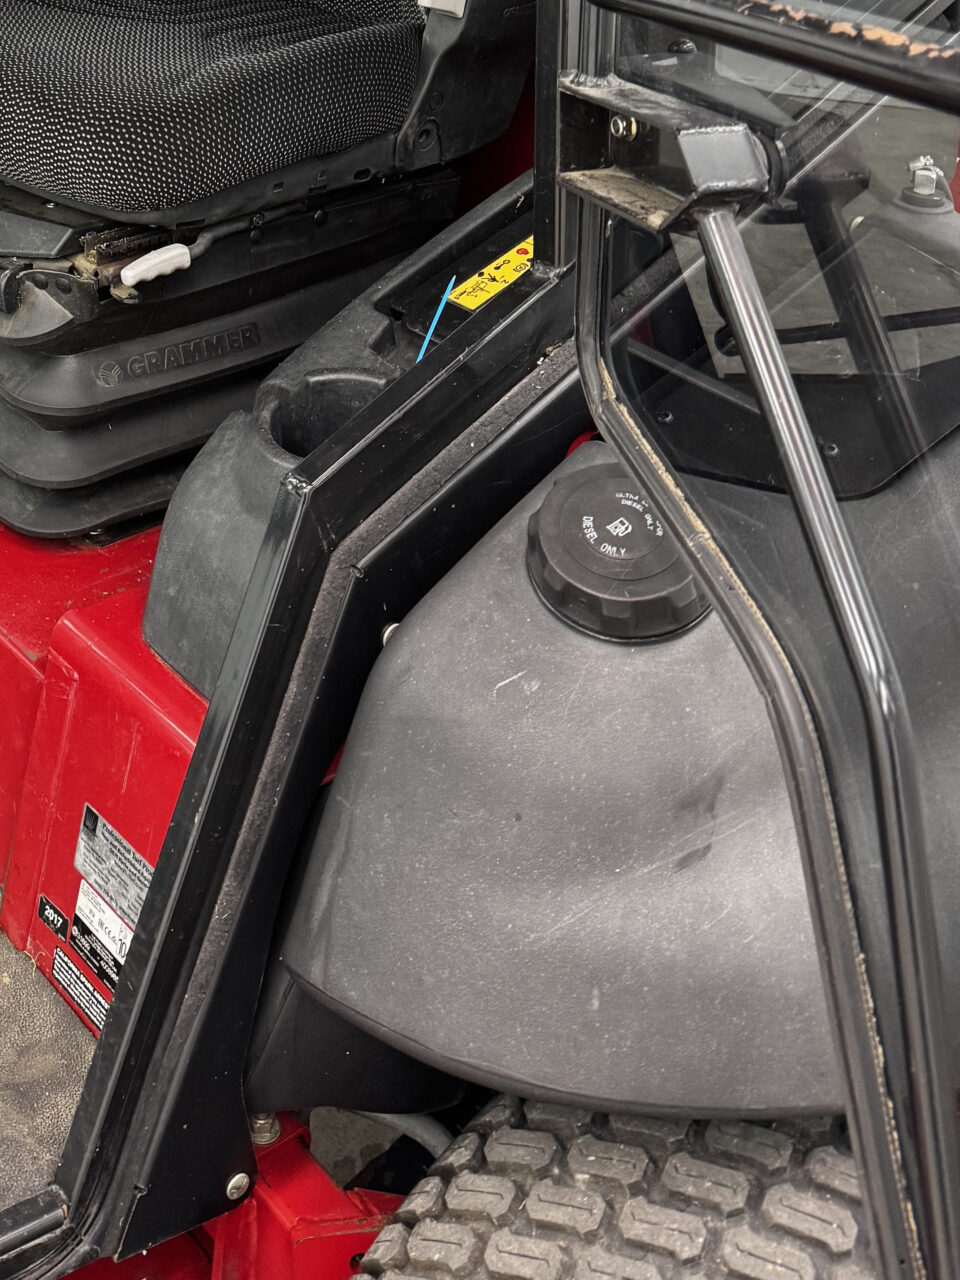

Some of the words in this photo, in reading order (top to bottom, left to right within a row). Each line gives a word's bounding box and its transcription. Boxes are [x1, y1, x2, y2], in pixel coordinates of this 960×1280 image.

[127, 325, 258, 378] GRAMMER
[621, 499, 644, 512] DIESEL
[582, 516, 598, 544] DIESEL
[600, 542, 626, 557] ONLY
[44, 905, 63, 929] 2017
